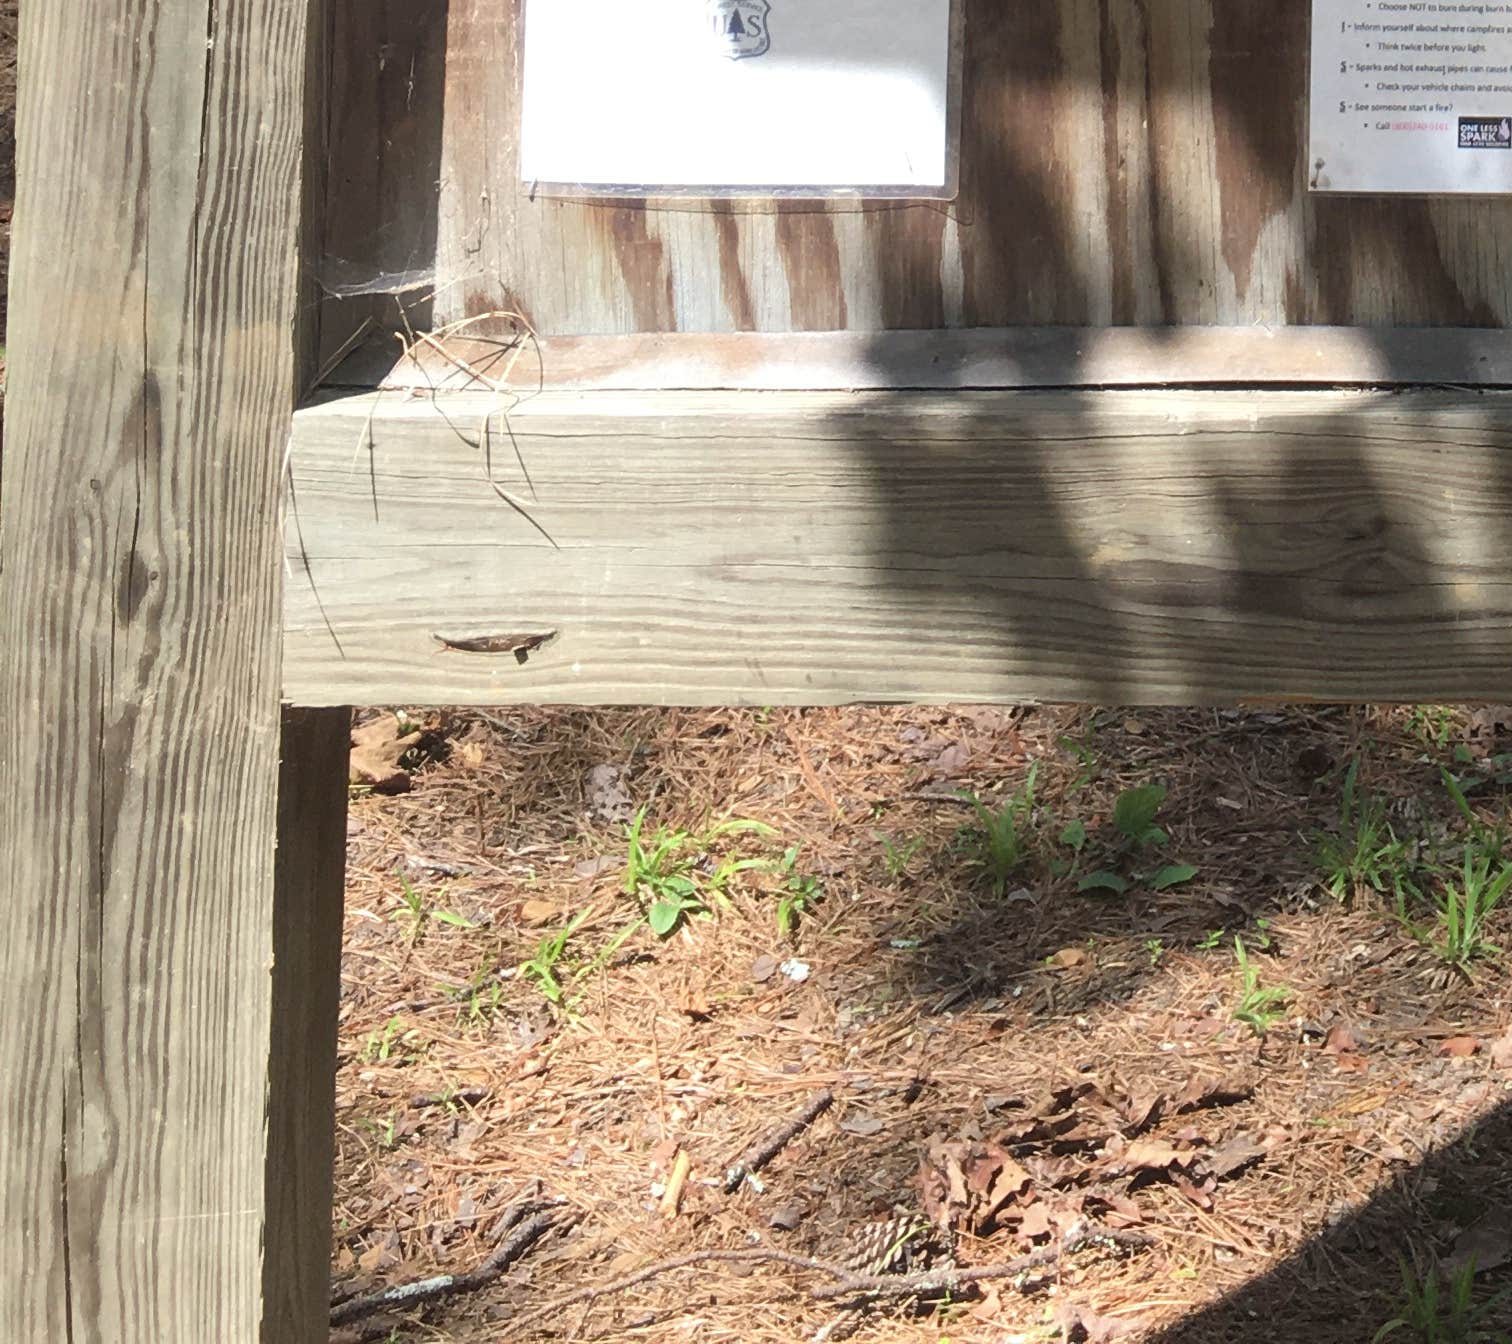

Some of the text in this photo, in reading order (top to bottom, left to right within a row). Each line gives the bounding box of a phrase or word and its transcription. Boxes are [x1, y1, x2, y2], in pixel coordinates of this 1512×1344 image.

[1378, 3, 1407, 12] Choose
[1409, 3, 1426, 12] NOT
[1428, 4, 1436, 12] to
[1438, 4, 1457, 12] burn
[1458, 4, 1483, 14] during
[1485, 4, 1504, 13] burn
[1354, 23, 1380, 31] Inform
[1382, 23, 1414, 34] yourself
[1416, 24, 1438, 32] about
[1440, 24, 1464, 33] where
[1466, 24, 1505, 35] campfires
[1378, 43, 1399, 51] Think
[1401, 43, 1422, 51] twice
[1424, 43, 1449, 52] before
[1451, 46, 1466, 54] you
[1356, 63, 1382, 73] Sparks
[1384, 64, 1398, 72] and
[1400, 64, 1413, 72] hot
[1415, 64, 1445, 73] exhaust
[1447, 65, 1468, 75] pipes
[1376, 83, 1400, 92] Check
[1401, 85, 1420, 94] your
[1421, 83, 1449, 92] vehicle
[1450, 84, 1476, 93] chains
[1477, 84, 1492, 93] and
[1408, 104, 1427, 112] start
[1460, 124, 1479, 132] ONE
[1460, 133, 1496, 141] SPARK
